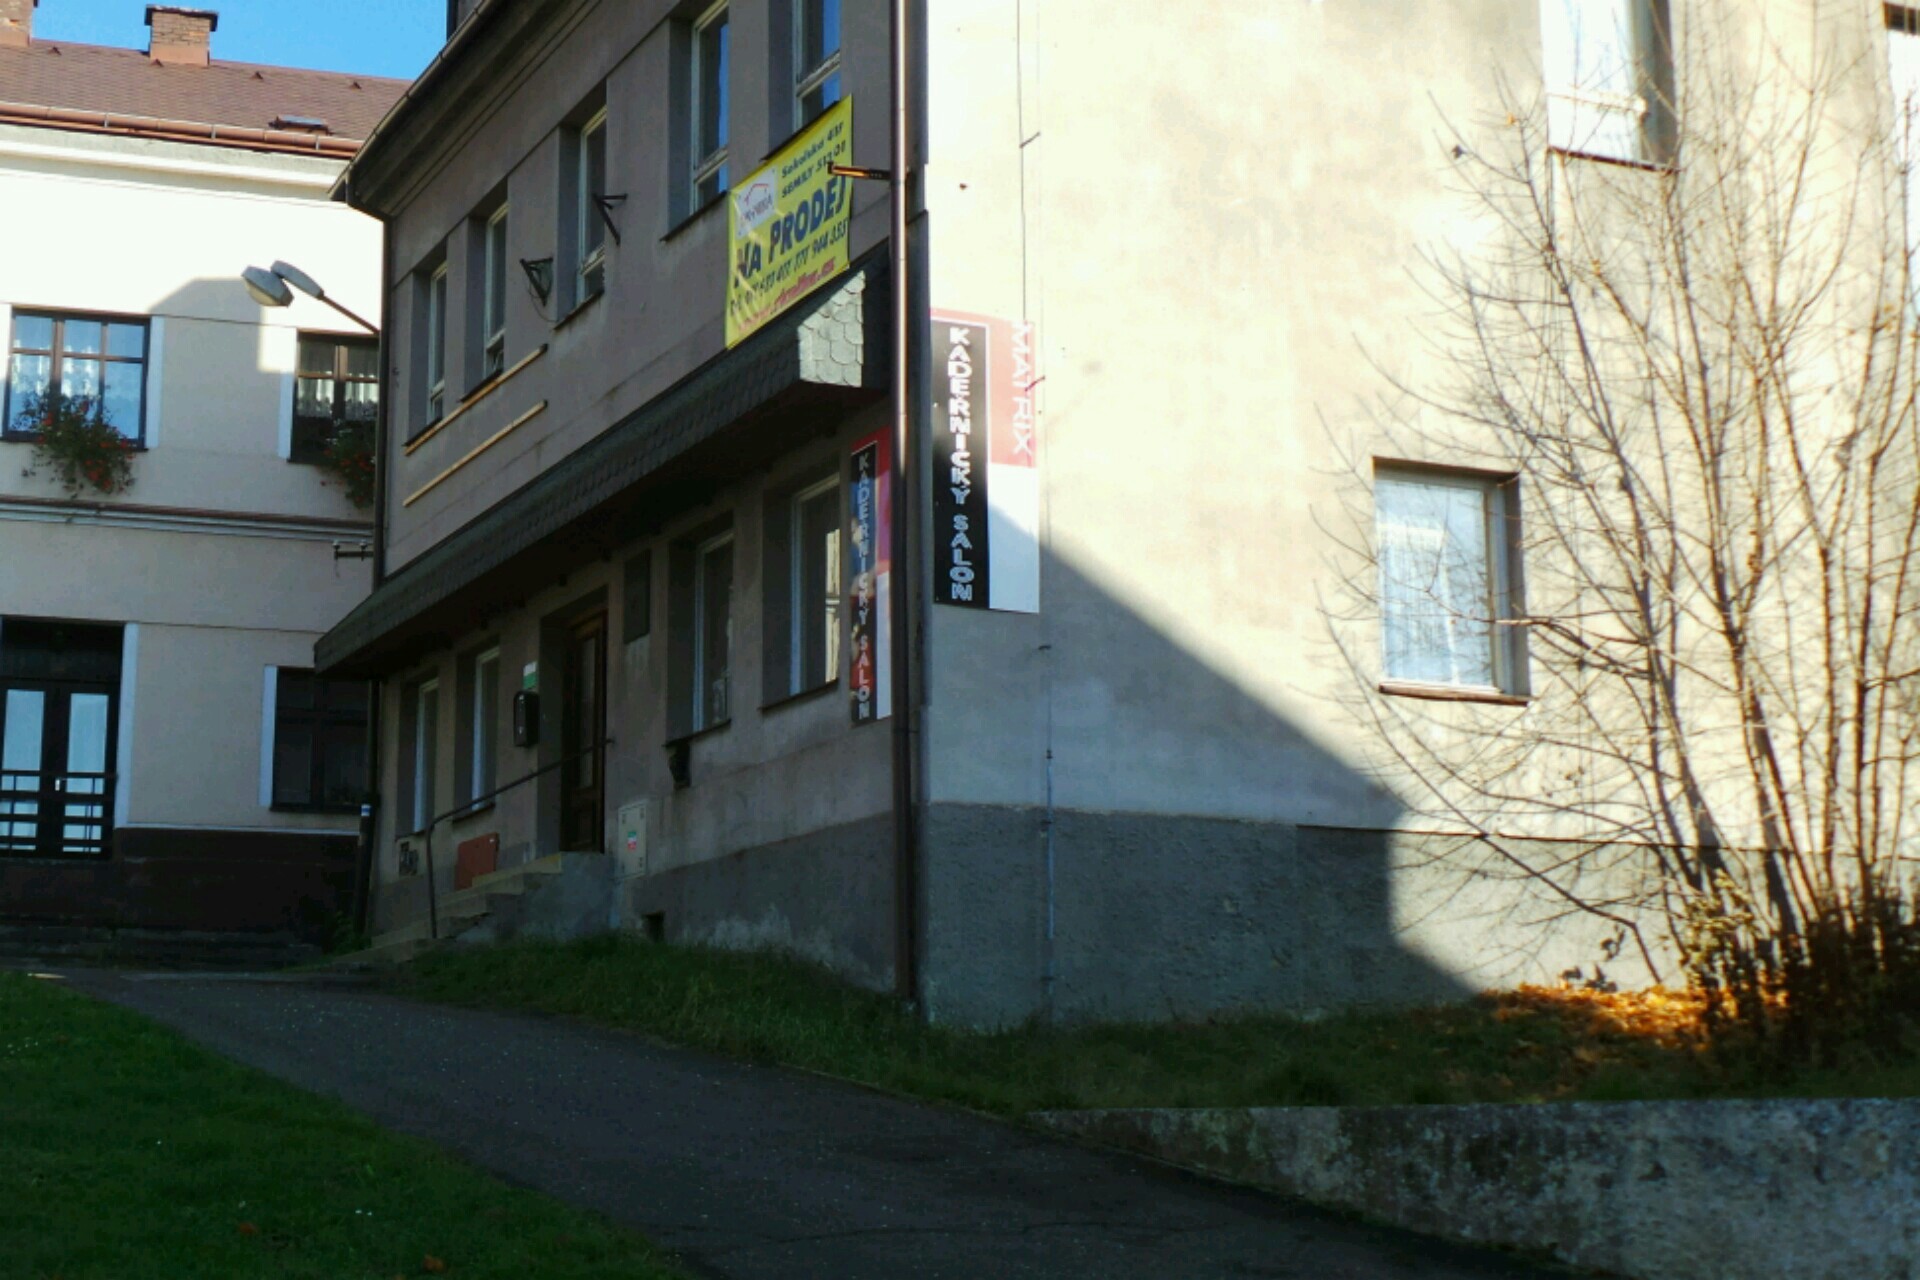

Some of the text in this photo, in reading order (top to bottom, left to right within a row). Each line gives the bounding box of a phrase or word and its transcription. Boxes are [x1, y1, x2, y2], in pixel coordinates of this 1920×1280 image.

[734, 241, 762, 289] NA
[768, 175, 847, 264] PRODEJ
[1011, 319, 1034, 456] MATRIX
[949, 514, 975, 602] SALON
[857, 635, 871, 720] SALON
